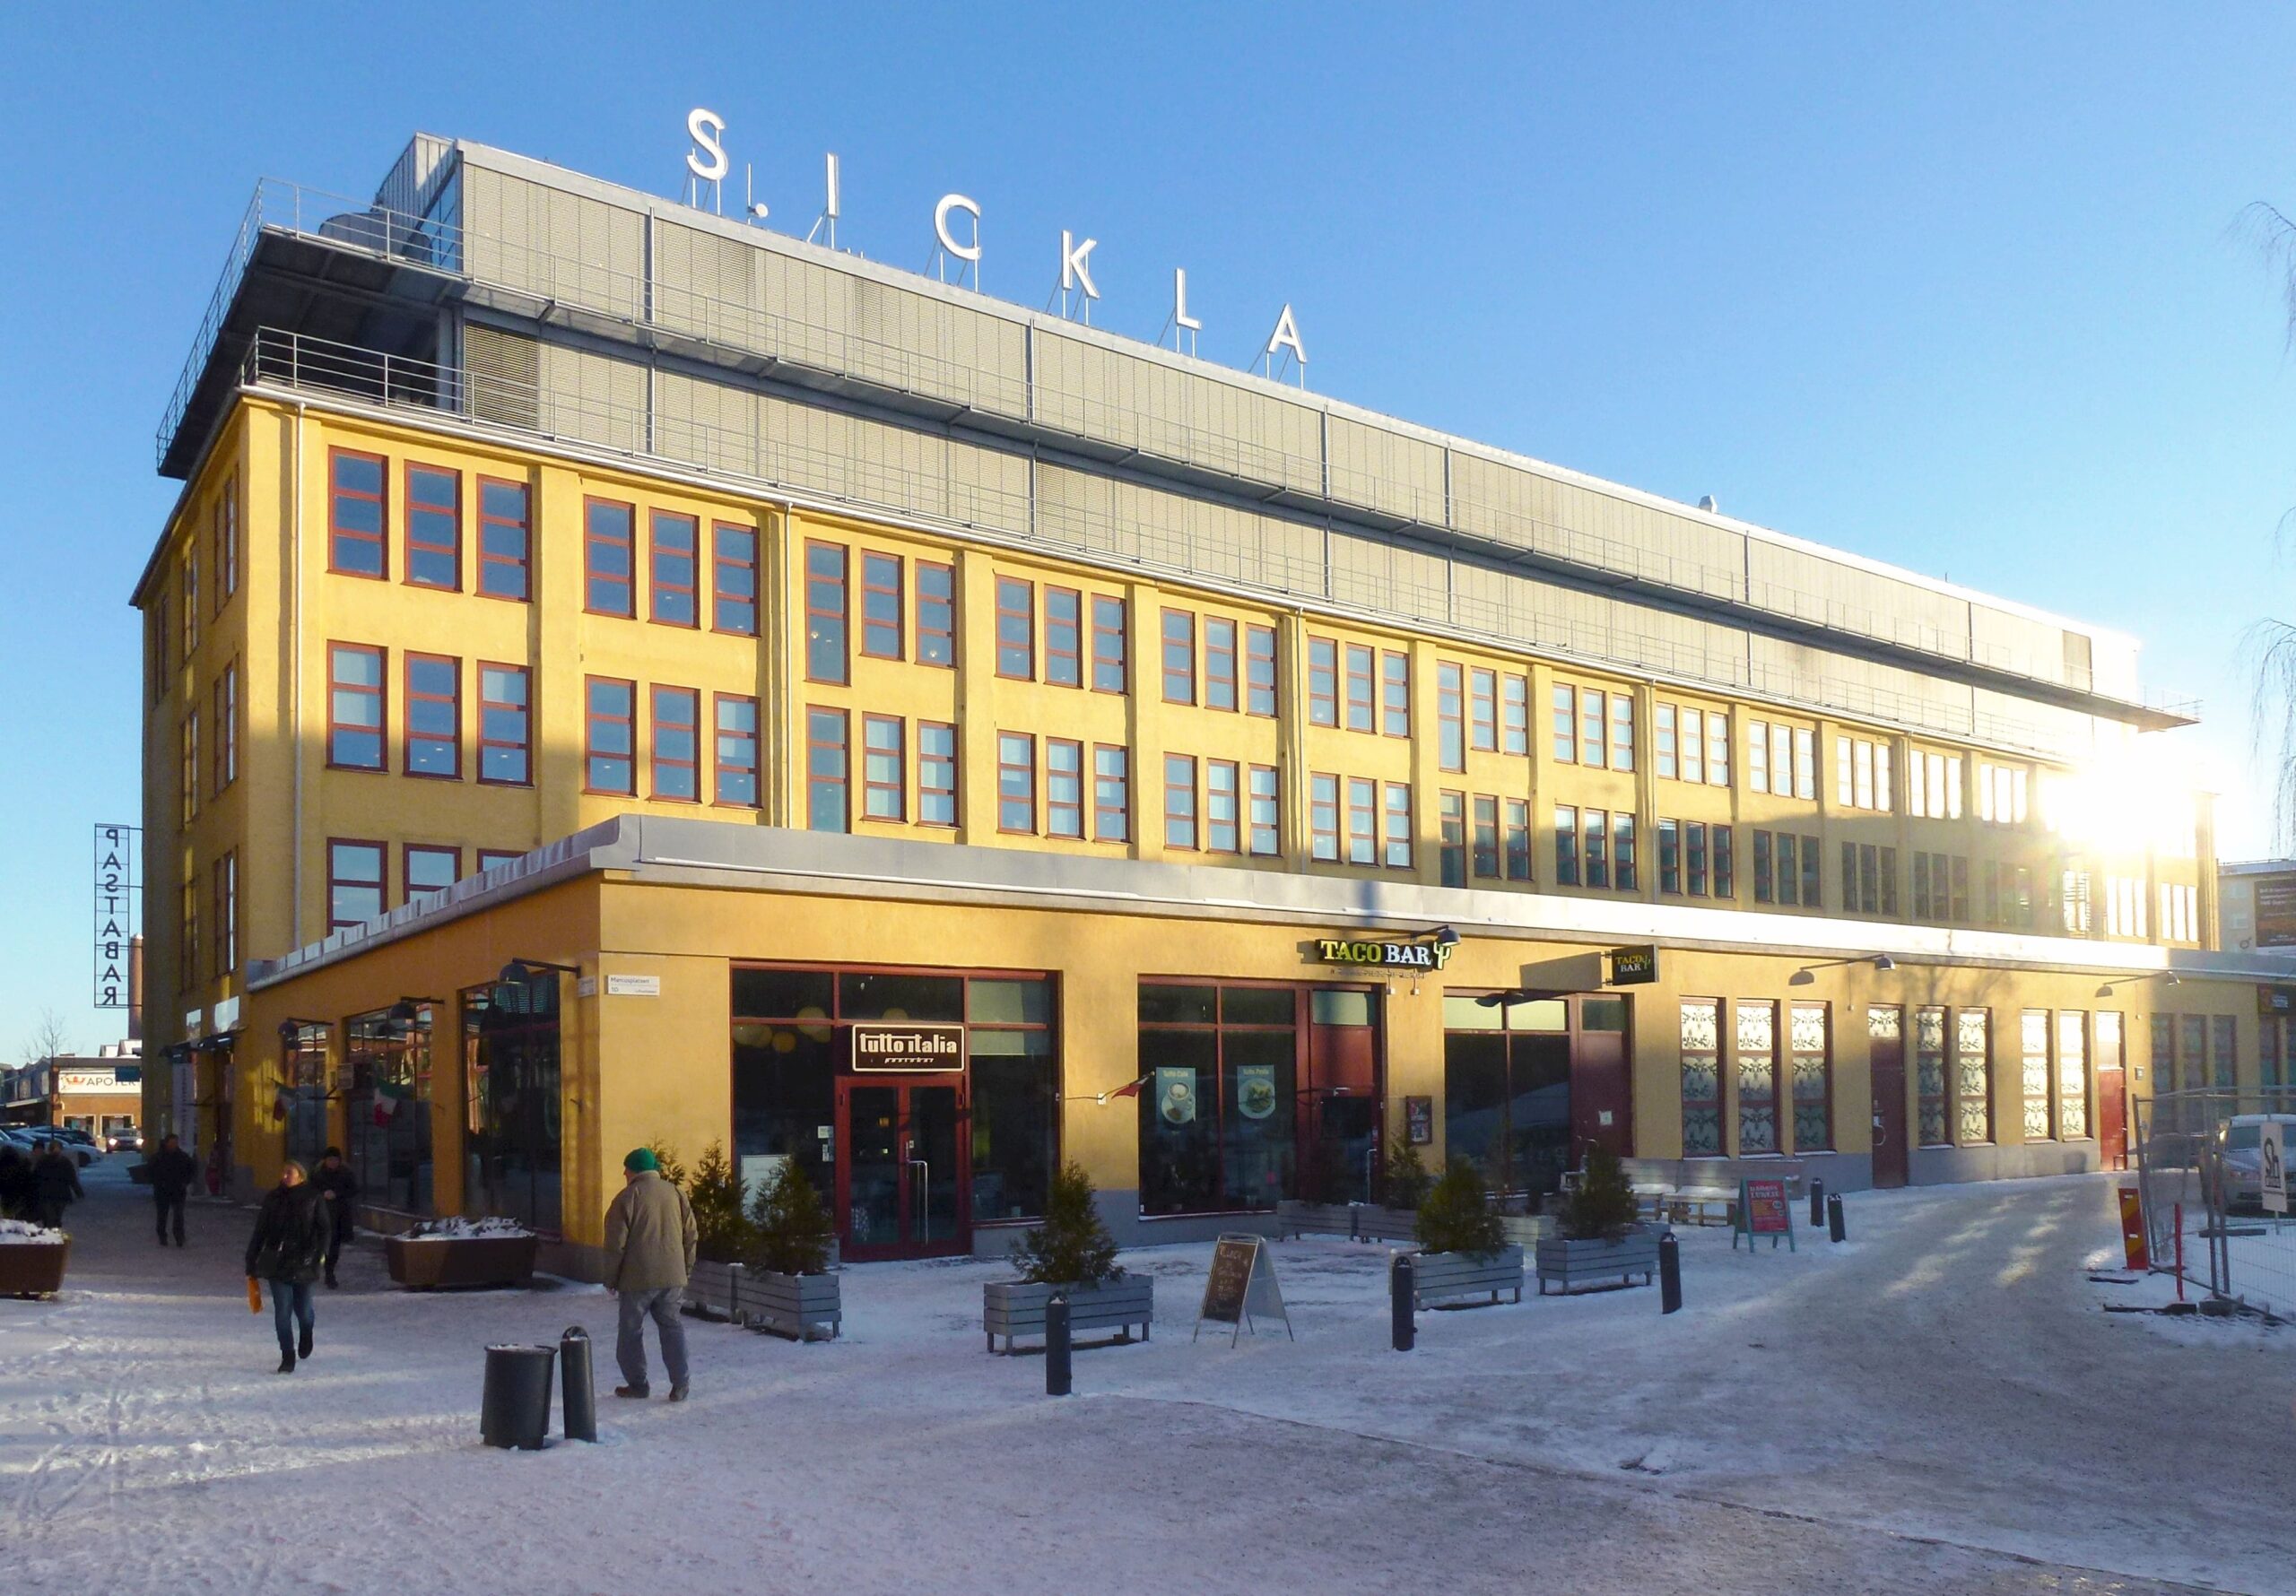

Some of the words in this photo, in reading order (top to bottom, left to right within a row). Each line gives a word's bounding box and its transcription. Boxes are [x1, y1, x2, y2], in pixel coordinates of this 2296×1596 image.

[686, 108, 1308, 364] SICKLA
[1320, 940, 1382, 963] TACO
[1385, 943, 1432, 966] BAR
[1615, 954, 1642, 966] TACO
[1621, 963, 1641, 973] BAR
[859, 1033, 904, 1053] tutto
[908, 1033, 957, 1054] italia
